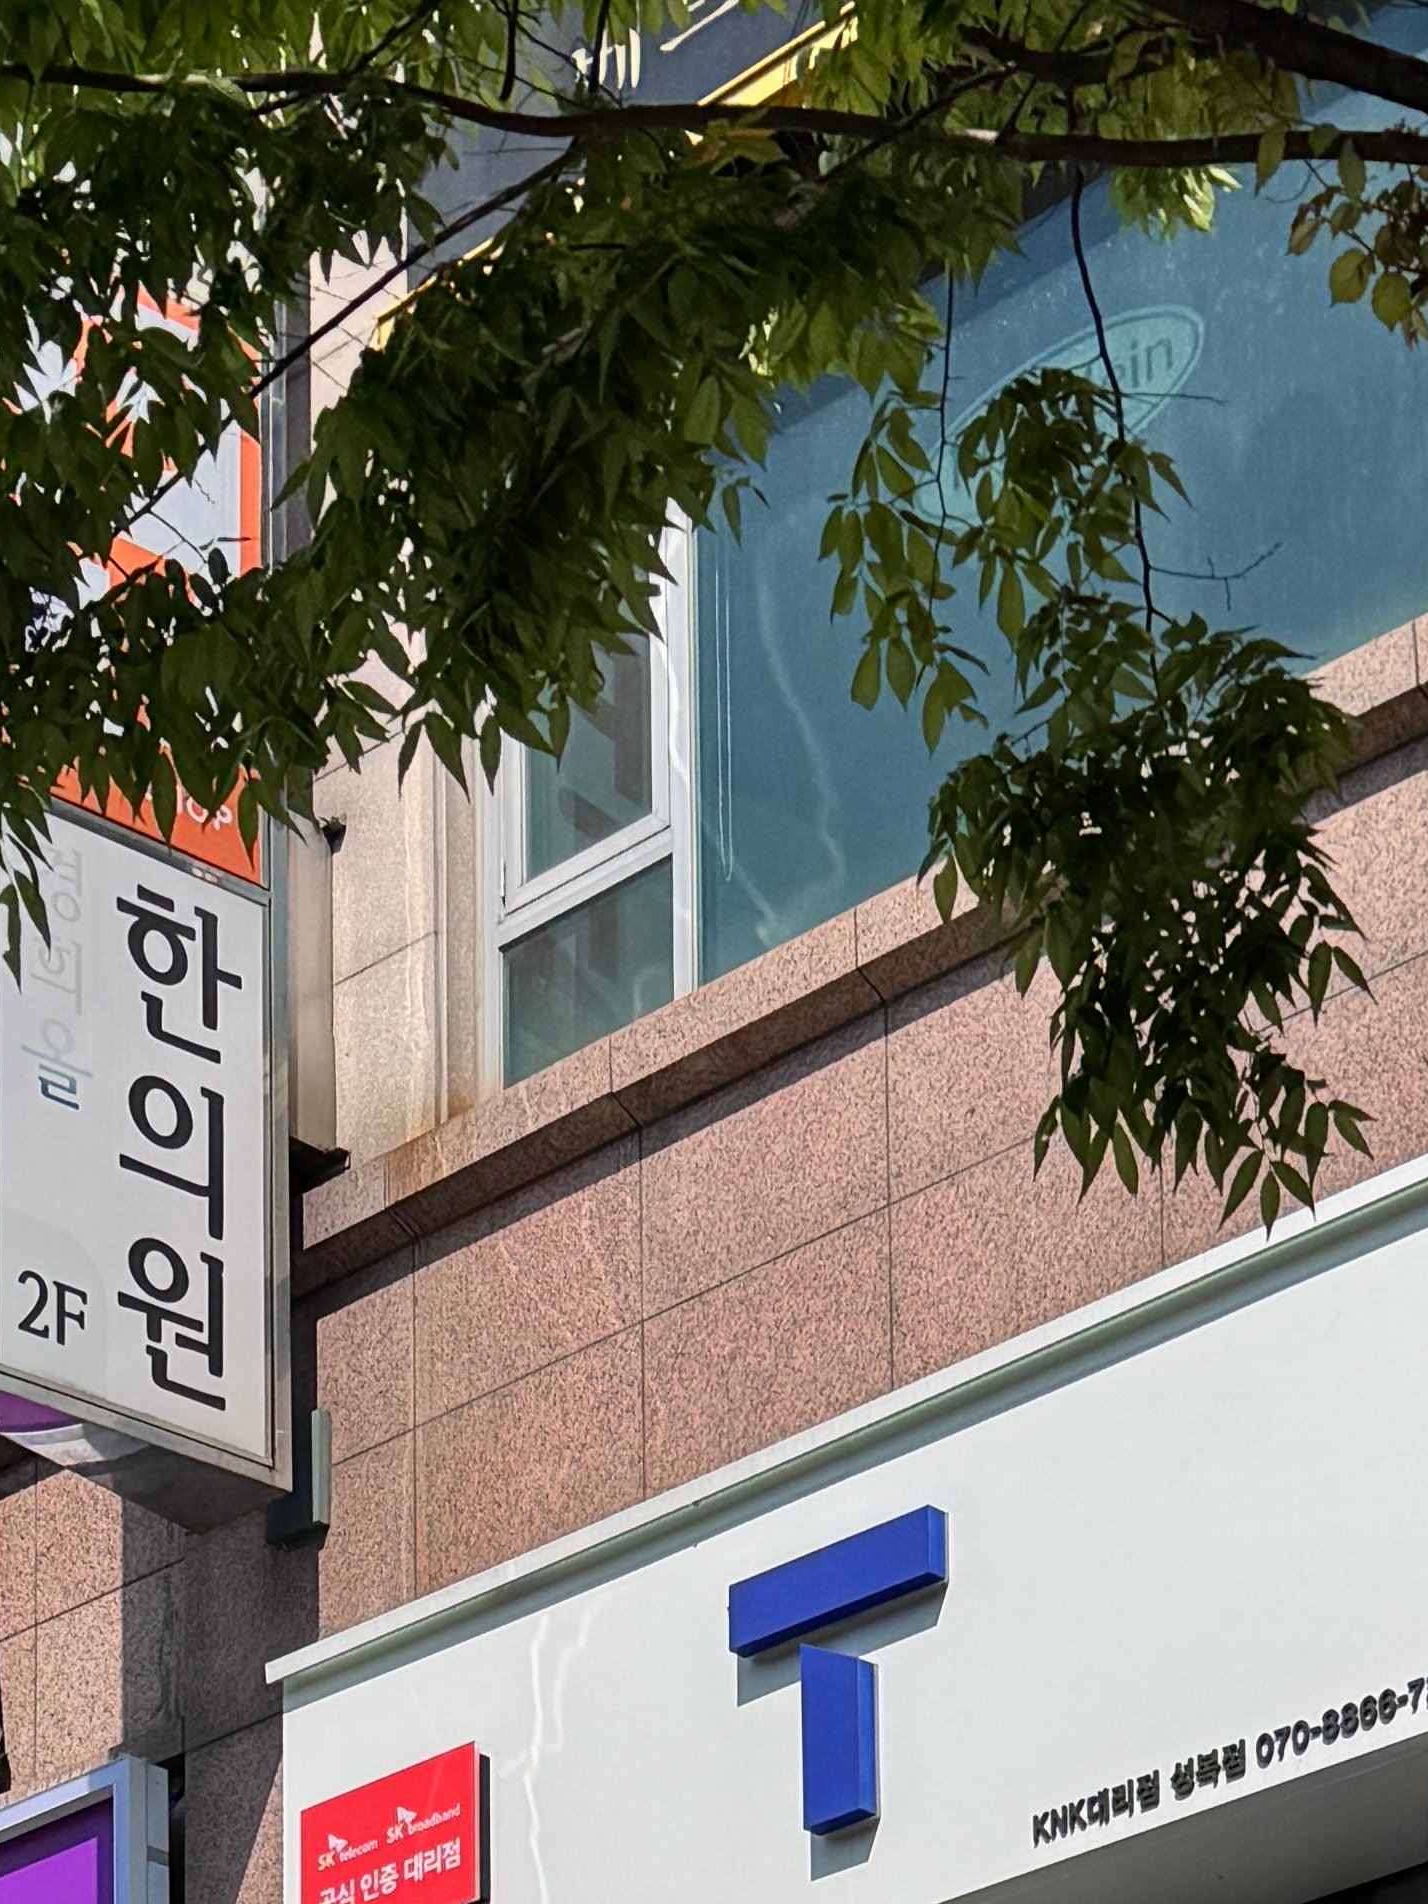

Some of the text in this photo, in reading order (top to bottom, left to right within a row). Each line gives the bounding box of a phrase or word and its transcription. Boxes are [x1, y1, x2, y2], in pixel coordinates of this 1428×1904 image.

[115, 883, 244, 1413] 한의원
[17, 1268, 88, 1347] 2F
[728, 1504, 949, 1836] T
[1032, 1769, 1161, 1848] KNK대리점
[1170, 1738, 1247, 1801] 성복점
[360, 1863, 399, 1902] 인증
[403, 1837, 461, 1882] 대리점
